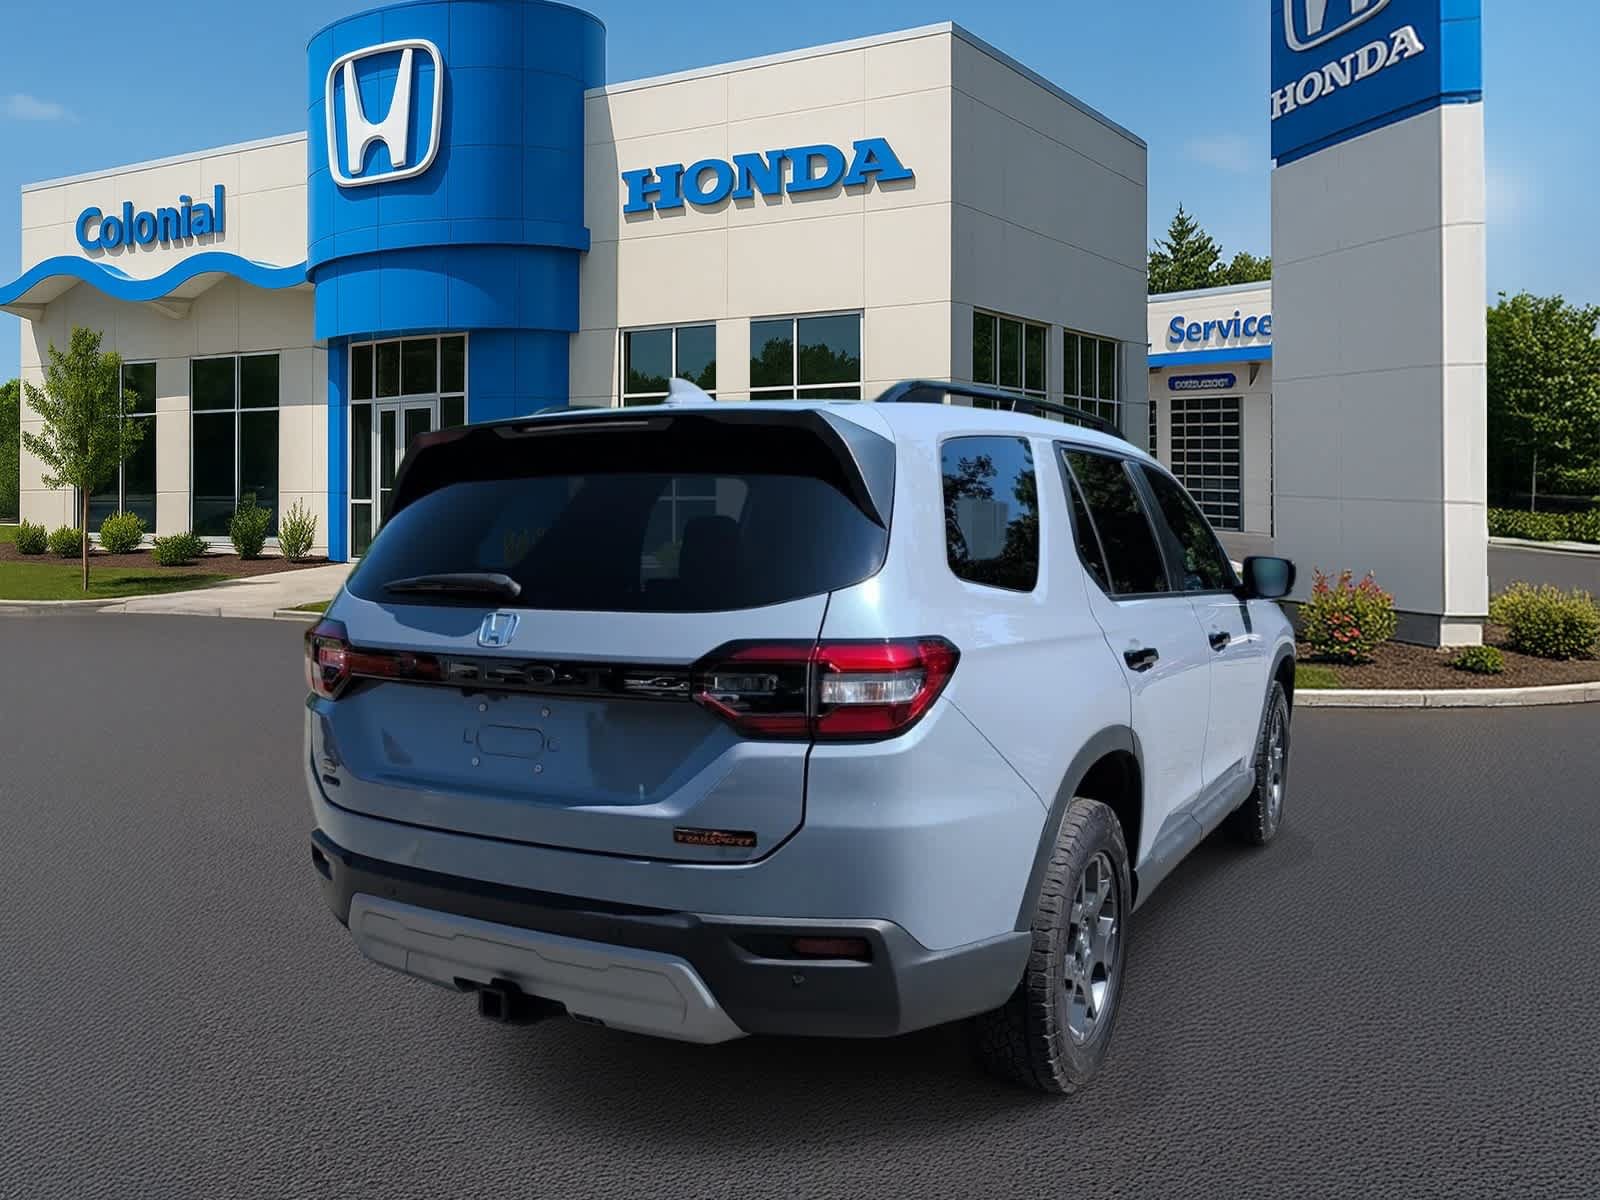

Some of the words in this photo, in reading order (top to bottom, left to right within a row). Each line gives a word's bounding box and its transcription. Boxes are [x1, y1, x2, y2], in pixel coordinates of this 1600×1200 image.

[1271, 25, 1425, 120] HONDA
[621, 137, 912, 213] HONDA
[76, 185, 226, 251] Colonial
[1169, 310, 1272, 343] Service
